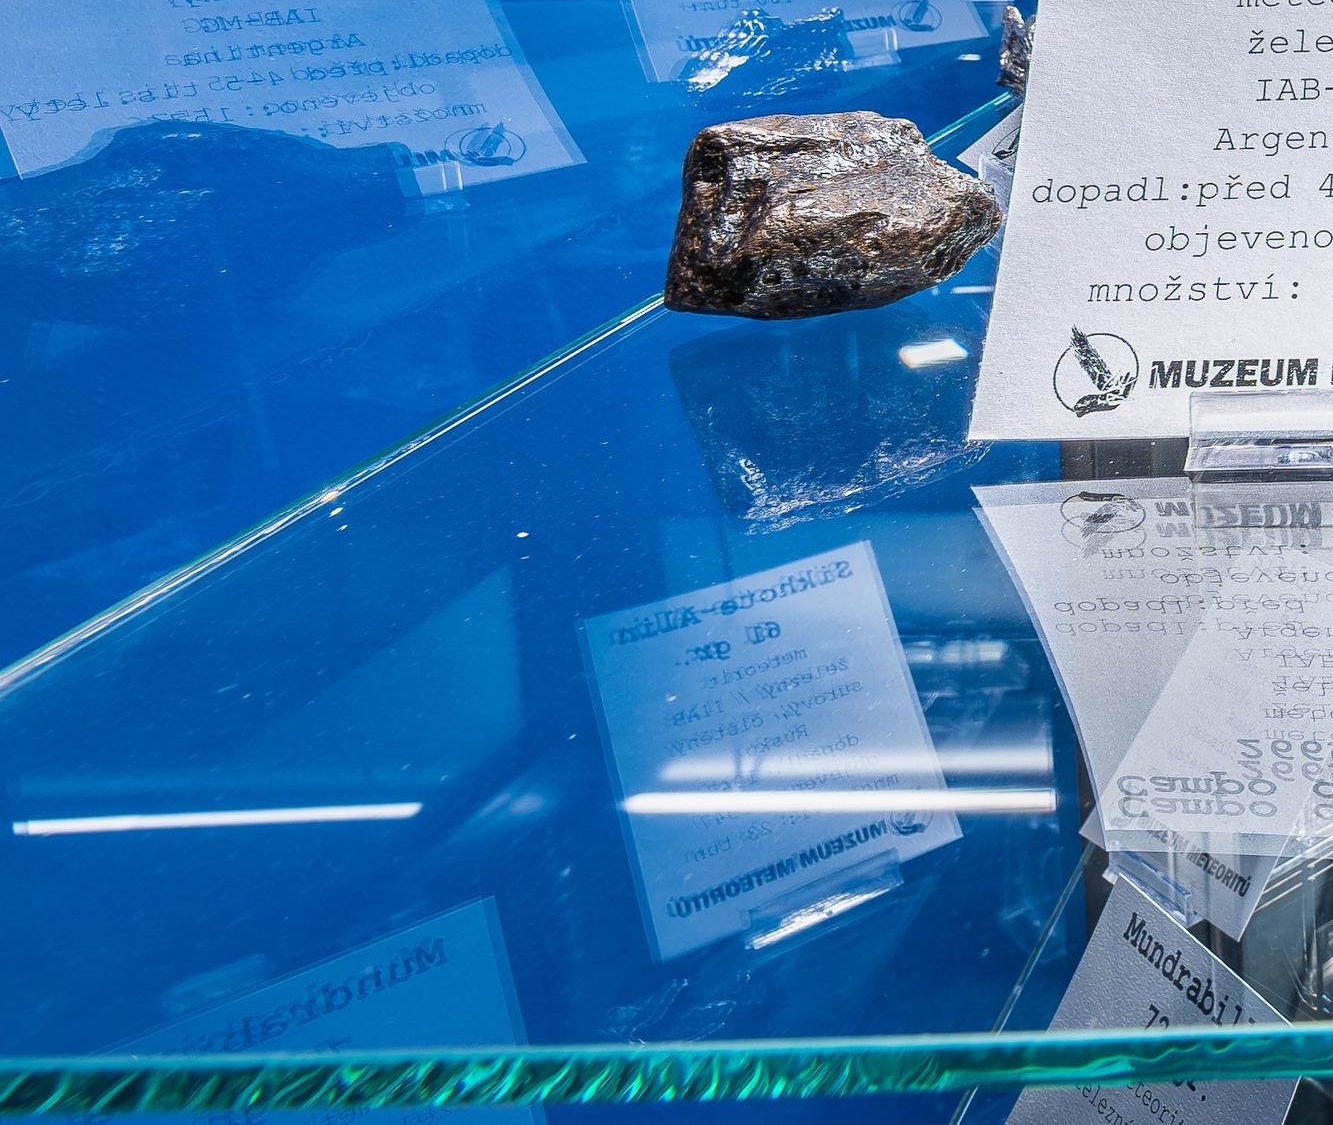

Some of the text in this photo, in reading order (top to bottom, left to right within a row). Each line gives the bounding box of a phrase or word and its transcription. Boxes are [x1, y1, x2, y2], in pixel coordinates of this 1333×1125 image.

[1032, 173, 1291, 209] dopadl:před
[1087, 274, 1300, 303] množství:
[1149, 358, 1318, 389] MUZEUM
